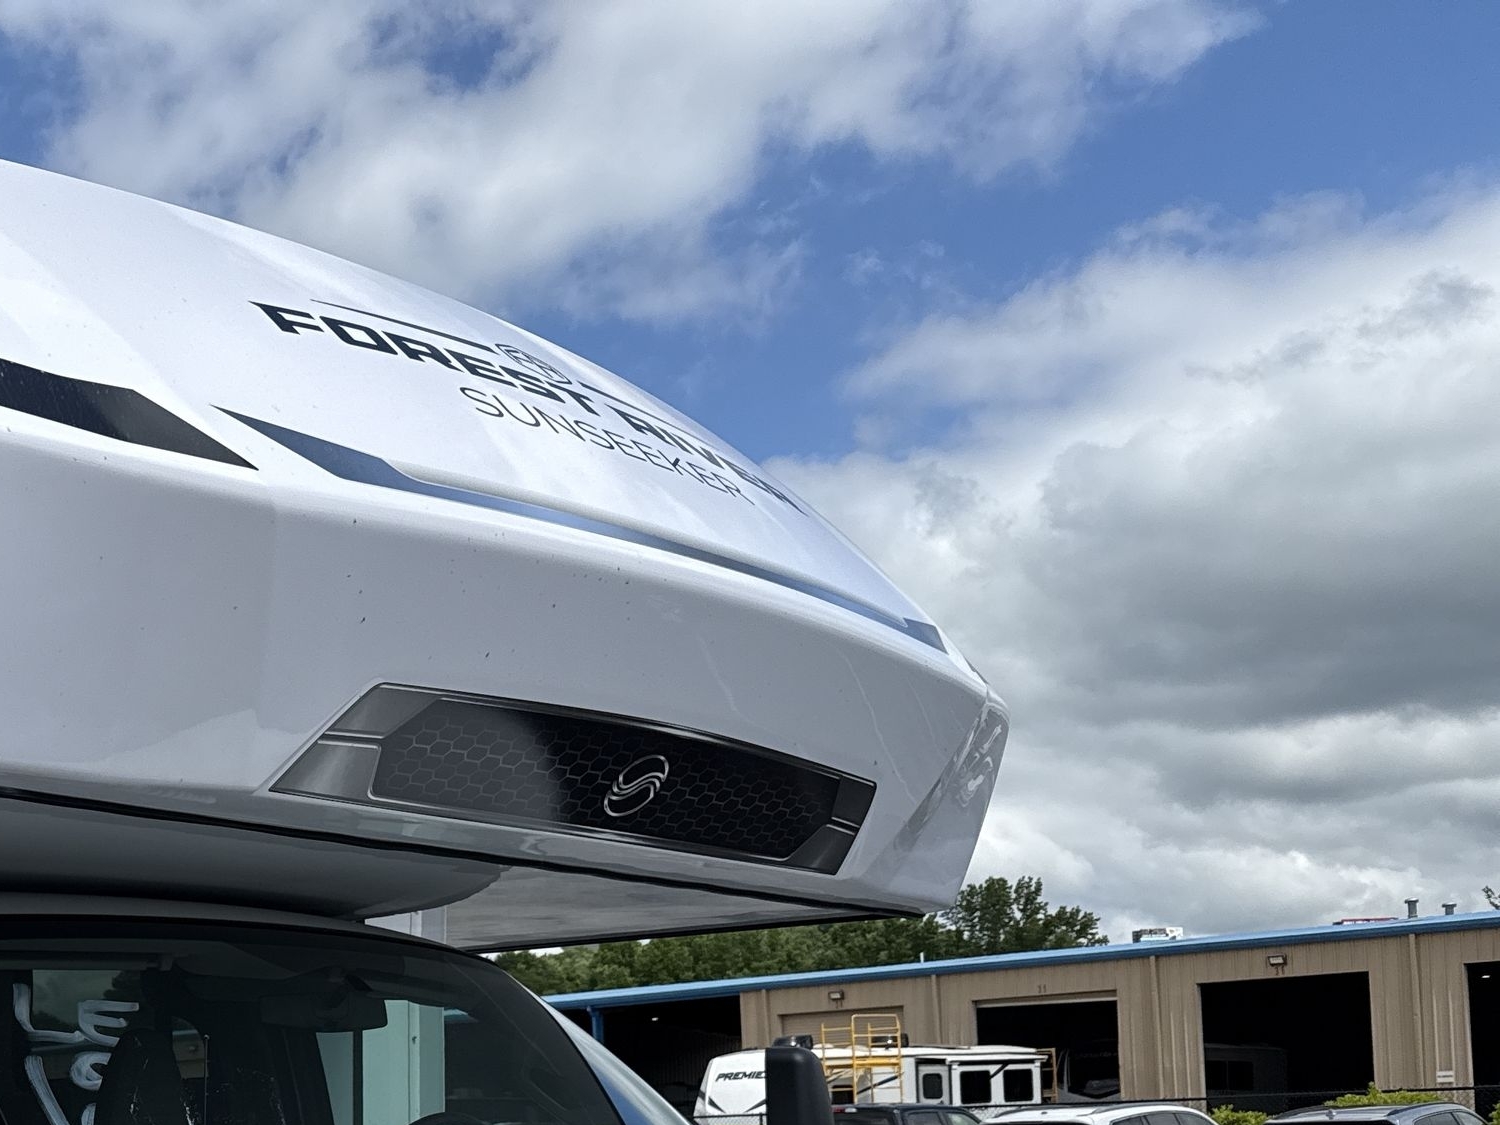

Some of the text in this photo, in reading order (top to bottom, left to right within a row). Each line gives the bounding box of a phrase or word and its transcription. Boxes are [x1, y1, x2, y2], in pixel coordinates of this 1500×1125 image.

[248, 301, 601, 417] FOREST
[459, 387, 755, 505] SUNSEEKER
[715, 1070, 767, 1082] PREMIE
